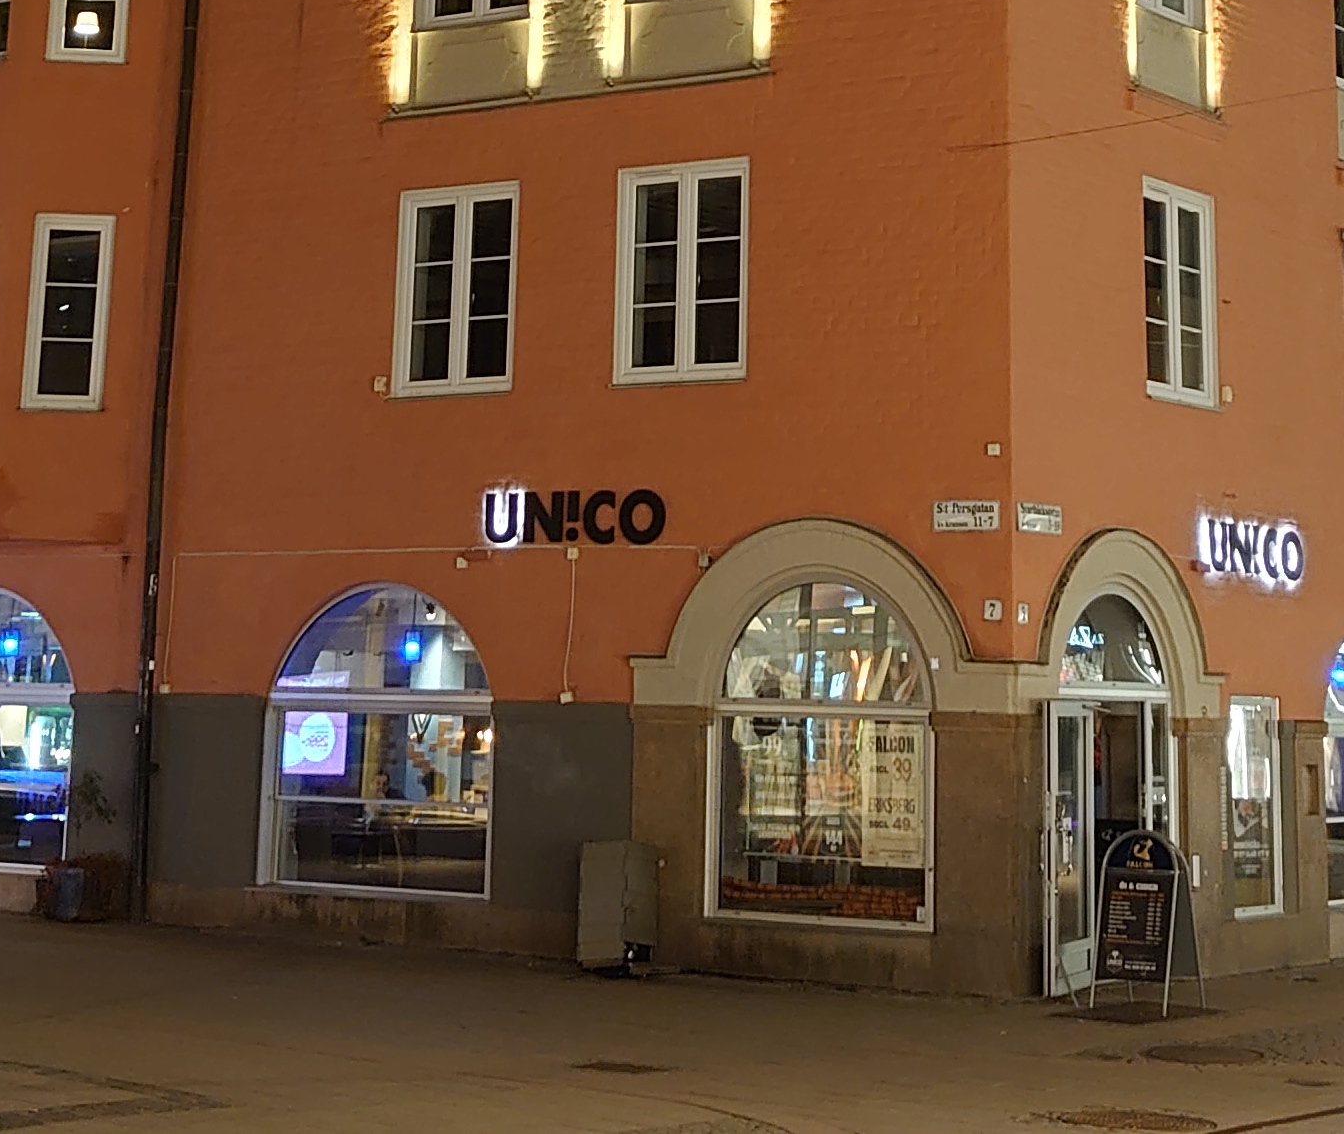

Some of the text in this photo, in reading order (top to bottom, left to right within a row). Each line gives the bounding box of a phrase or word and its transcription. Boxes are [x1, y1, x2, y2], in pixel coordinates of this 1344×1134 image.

[952, 502, 995, 516] Persgatan
[973, 516, 994, 527] 11-7
[988, 602, 996, 618] 7
[868, 797, 915, 814] ERIKSBERG
